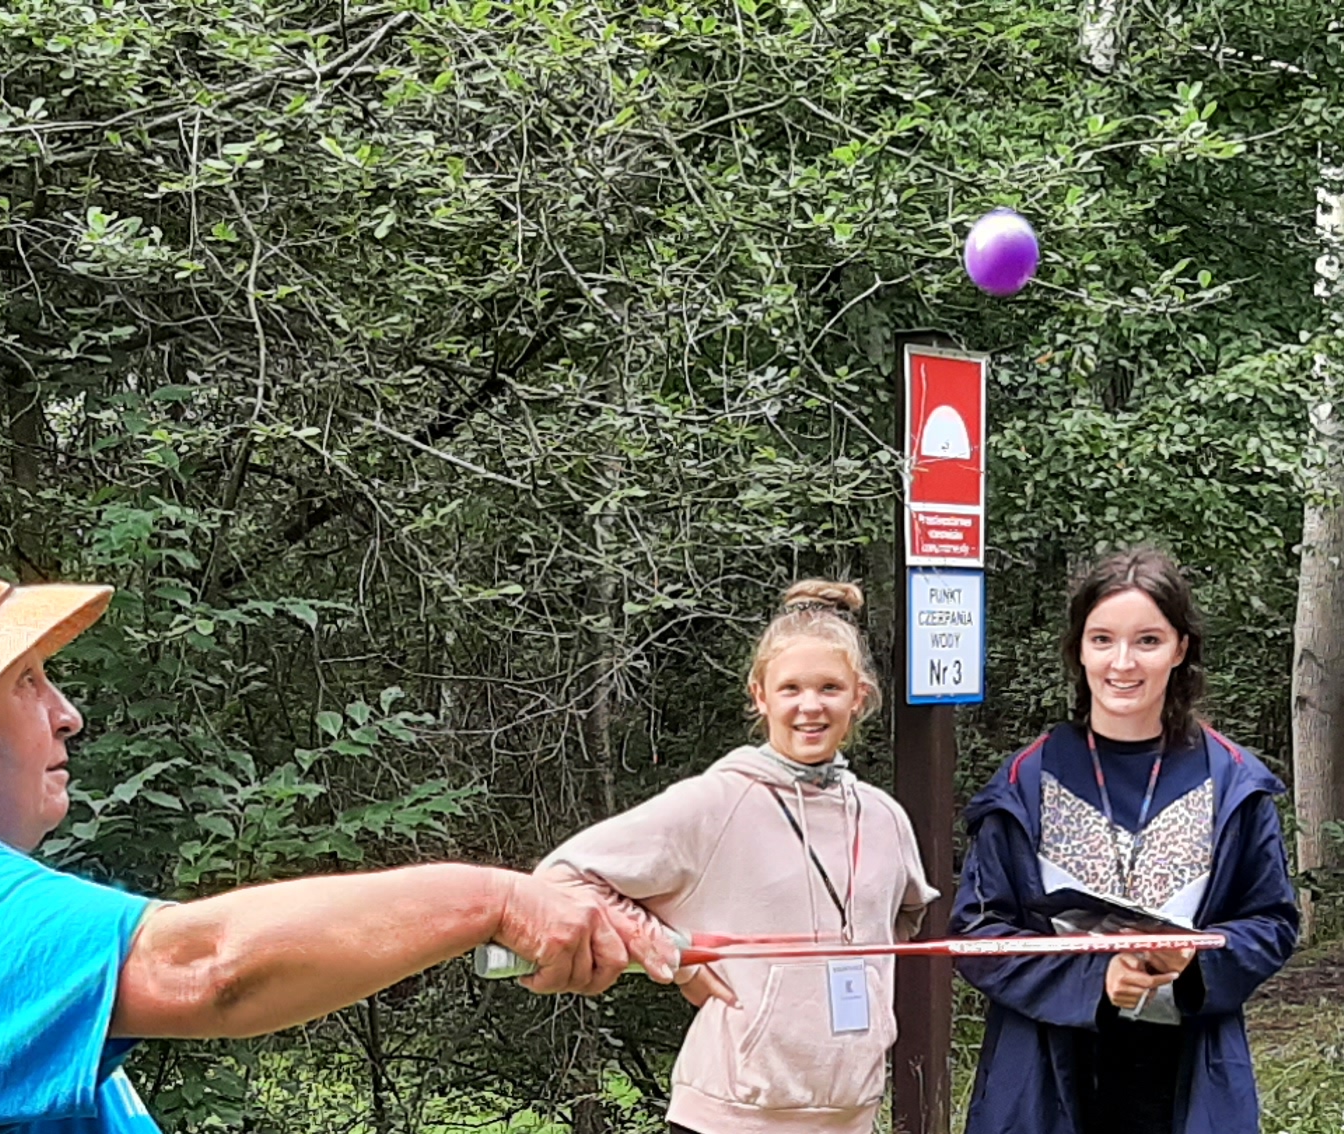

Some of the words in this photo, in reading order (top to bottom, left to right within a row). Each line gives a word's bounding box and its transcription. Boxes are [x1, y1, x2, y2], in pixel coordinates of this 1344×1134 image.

[929, 587, 962, 604] PUNKT
[917, 610, 973, 626] CZERPANIA
[930, 633, 960, 648] WODY
[929, 659, 948, 686] Nr
[952, 659, 962, 685] 3
